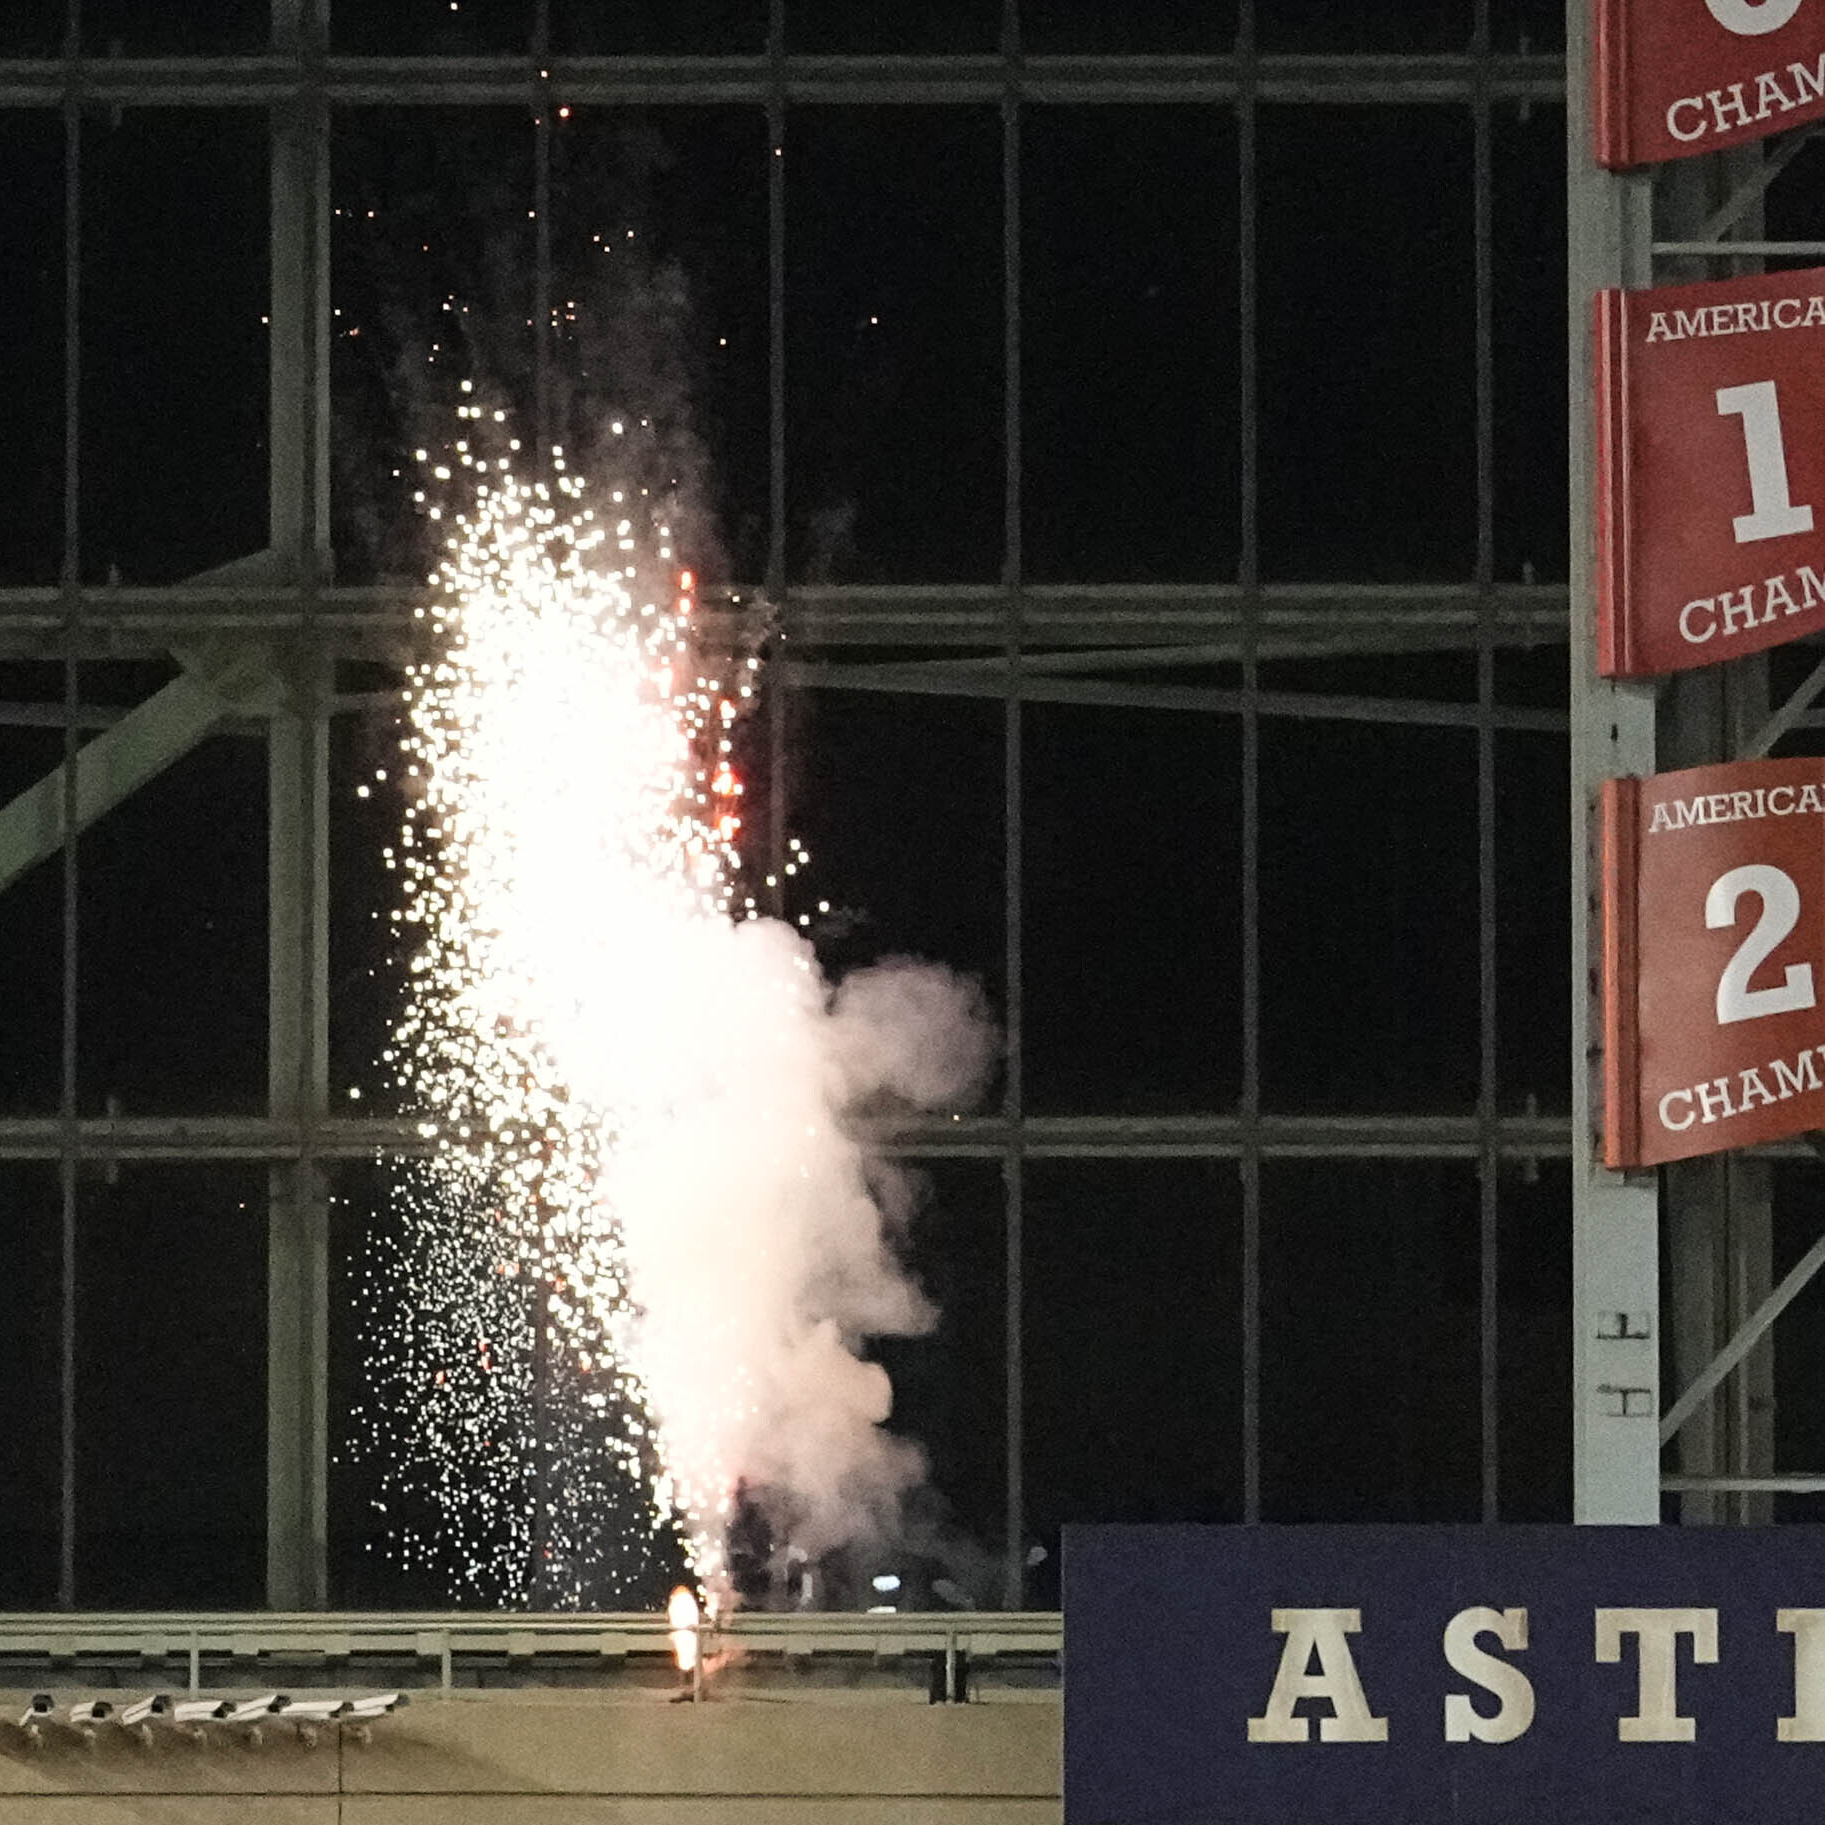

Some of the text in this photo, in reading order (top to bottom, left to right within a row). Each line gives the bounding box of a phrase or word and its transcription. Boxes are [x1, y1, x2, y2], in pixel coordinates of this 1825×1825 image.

[1717, 381, 1814, 543] 1
[1648, 784, 1825, 832] AMERICA
[1705, 864, 1816, 1025] 2
[1658, 1045, 1825, 1131] CHAM
